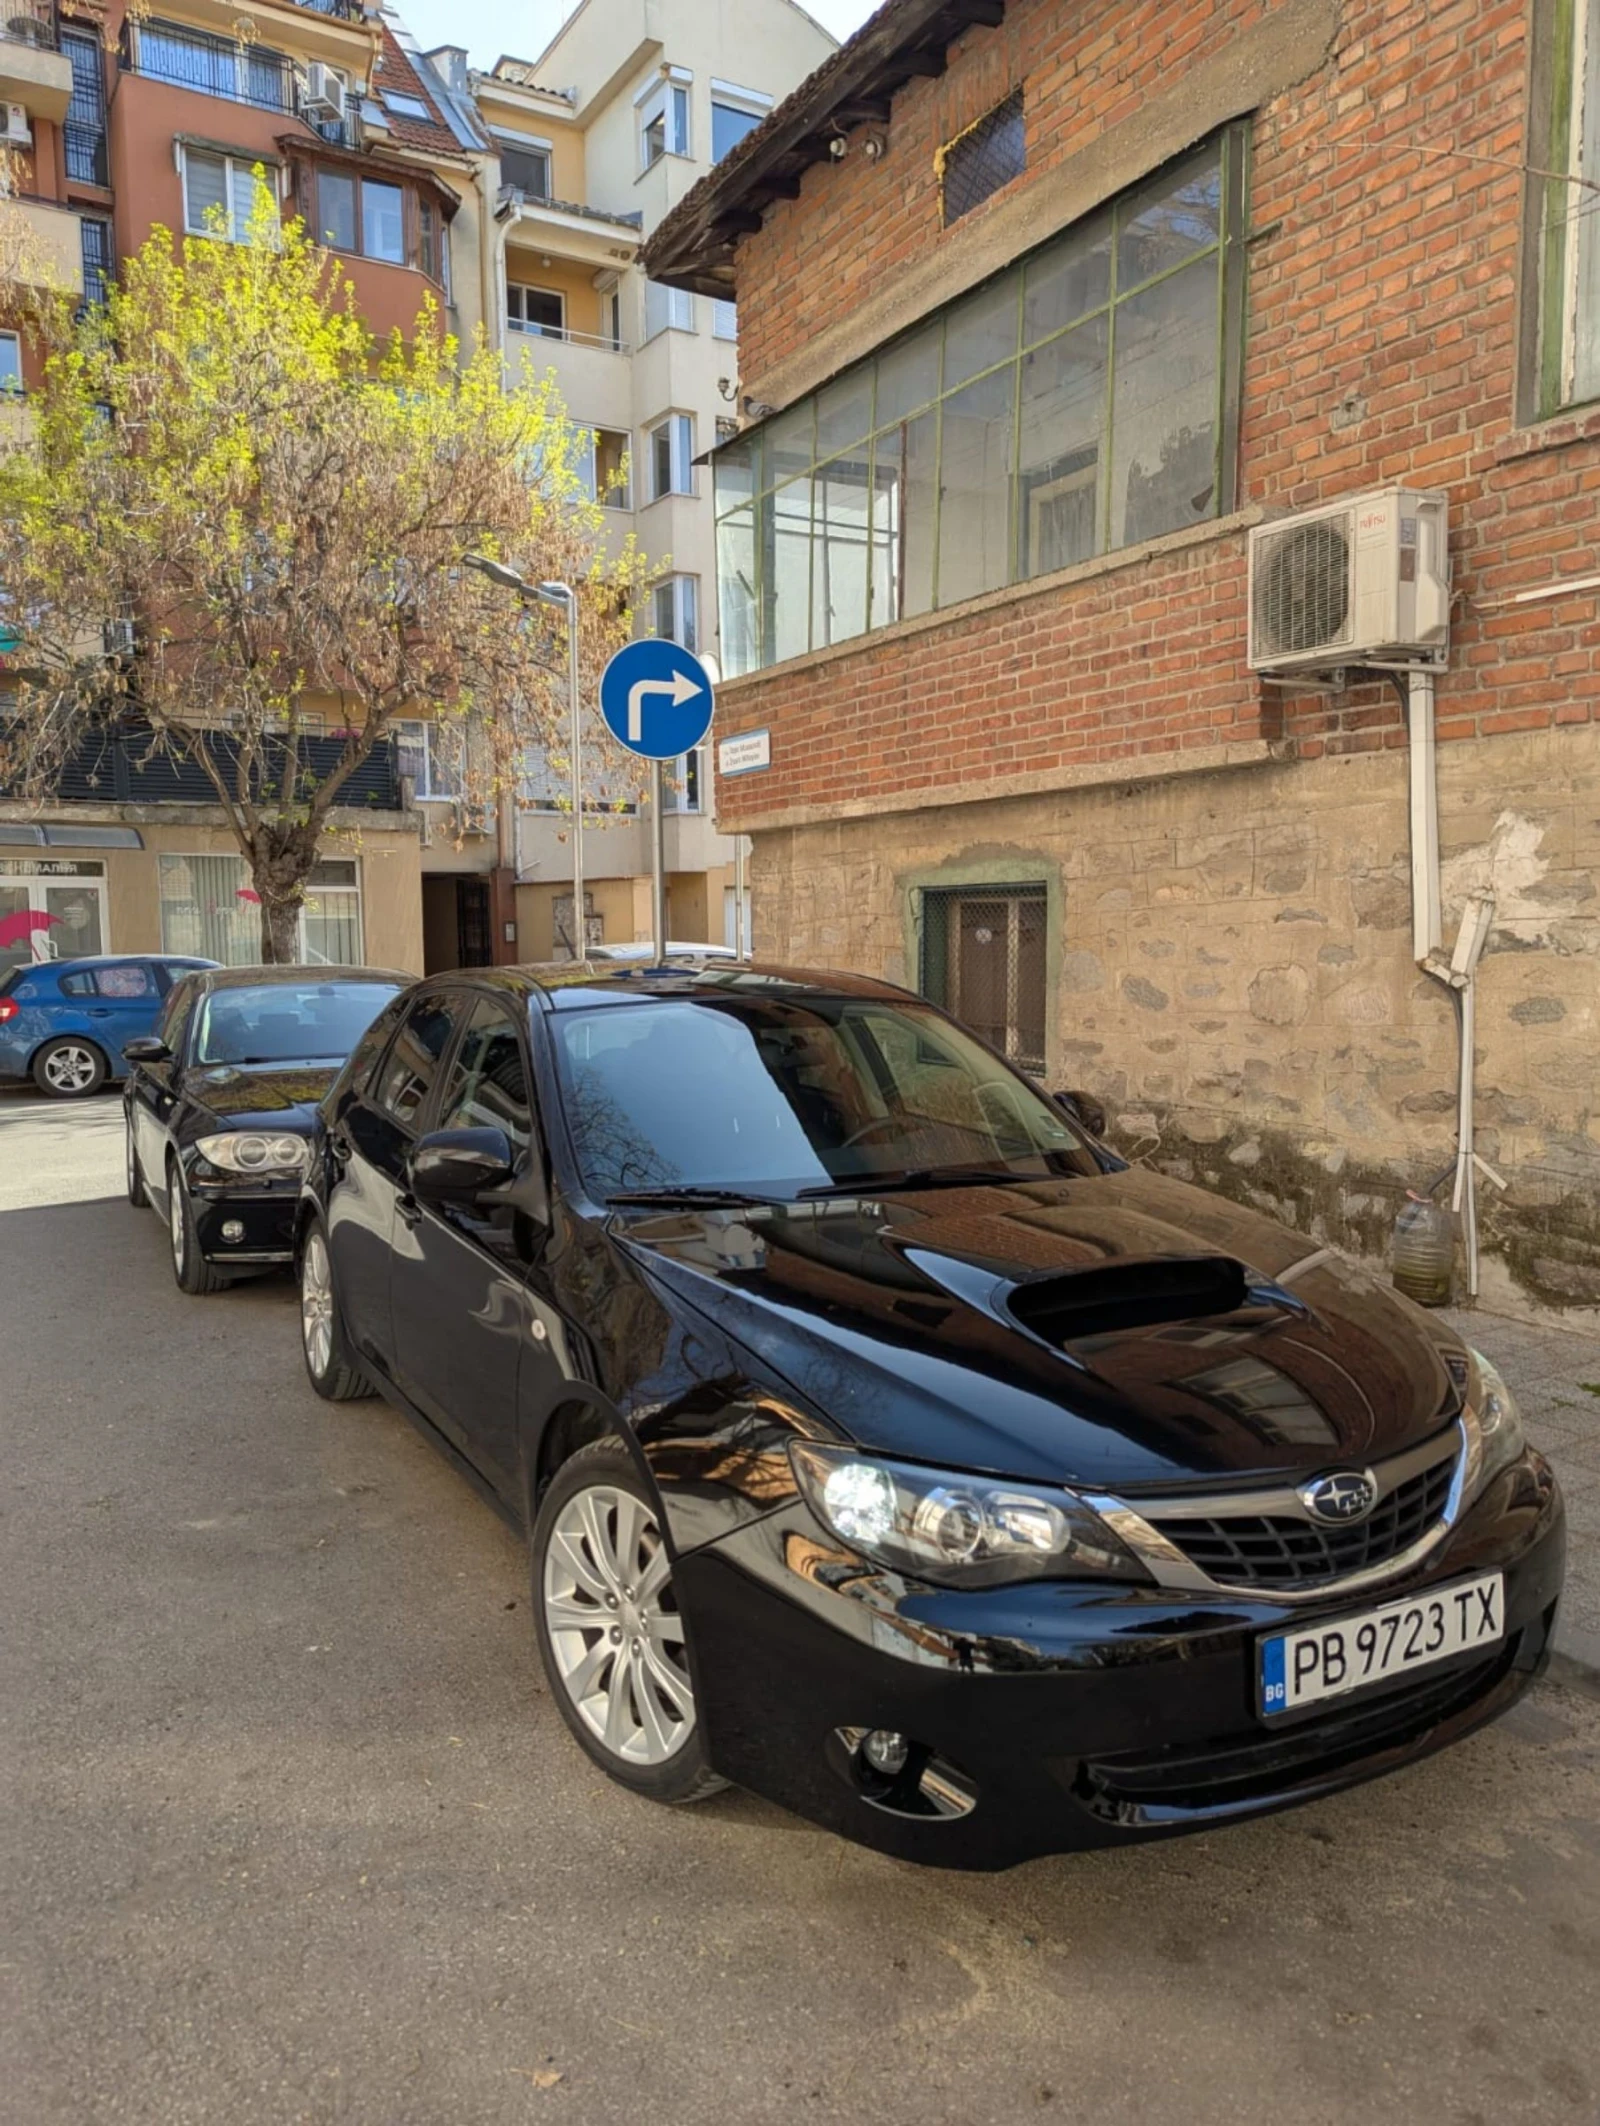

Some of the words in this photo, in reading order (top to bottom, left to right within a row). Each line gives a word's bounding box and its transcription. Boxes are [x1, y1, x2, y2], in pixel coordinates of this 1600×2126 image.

[1294, 1631, 1347, 1696] PB
[1356, 1601, 1445, 1676] 9723
[1454, 1582, 1497, 1643] TX
[1265, 1682, 1285, 1702] BG
